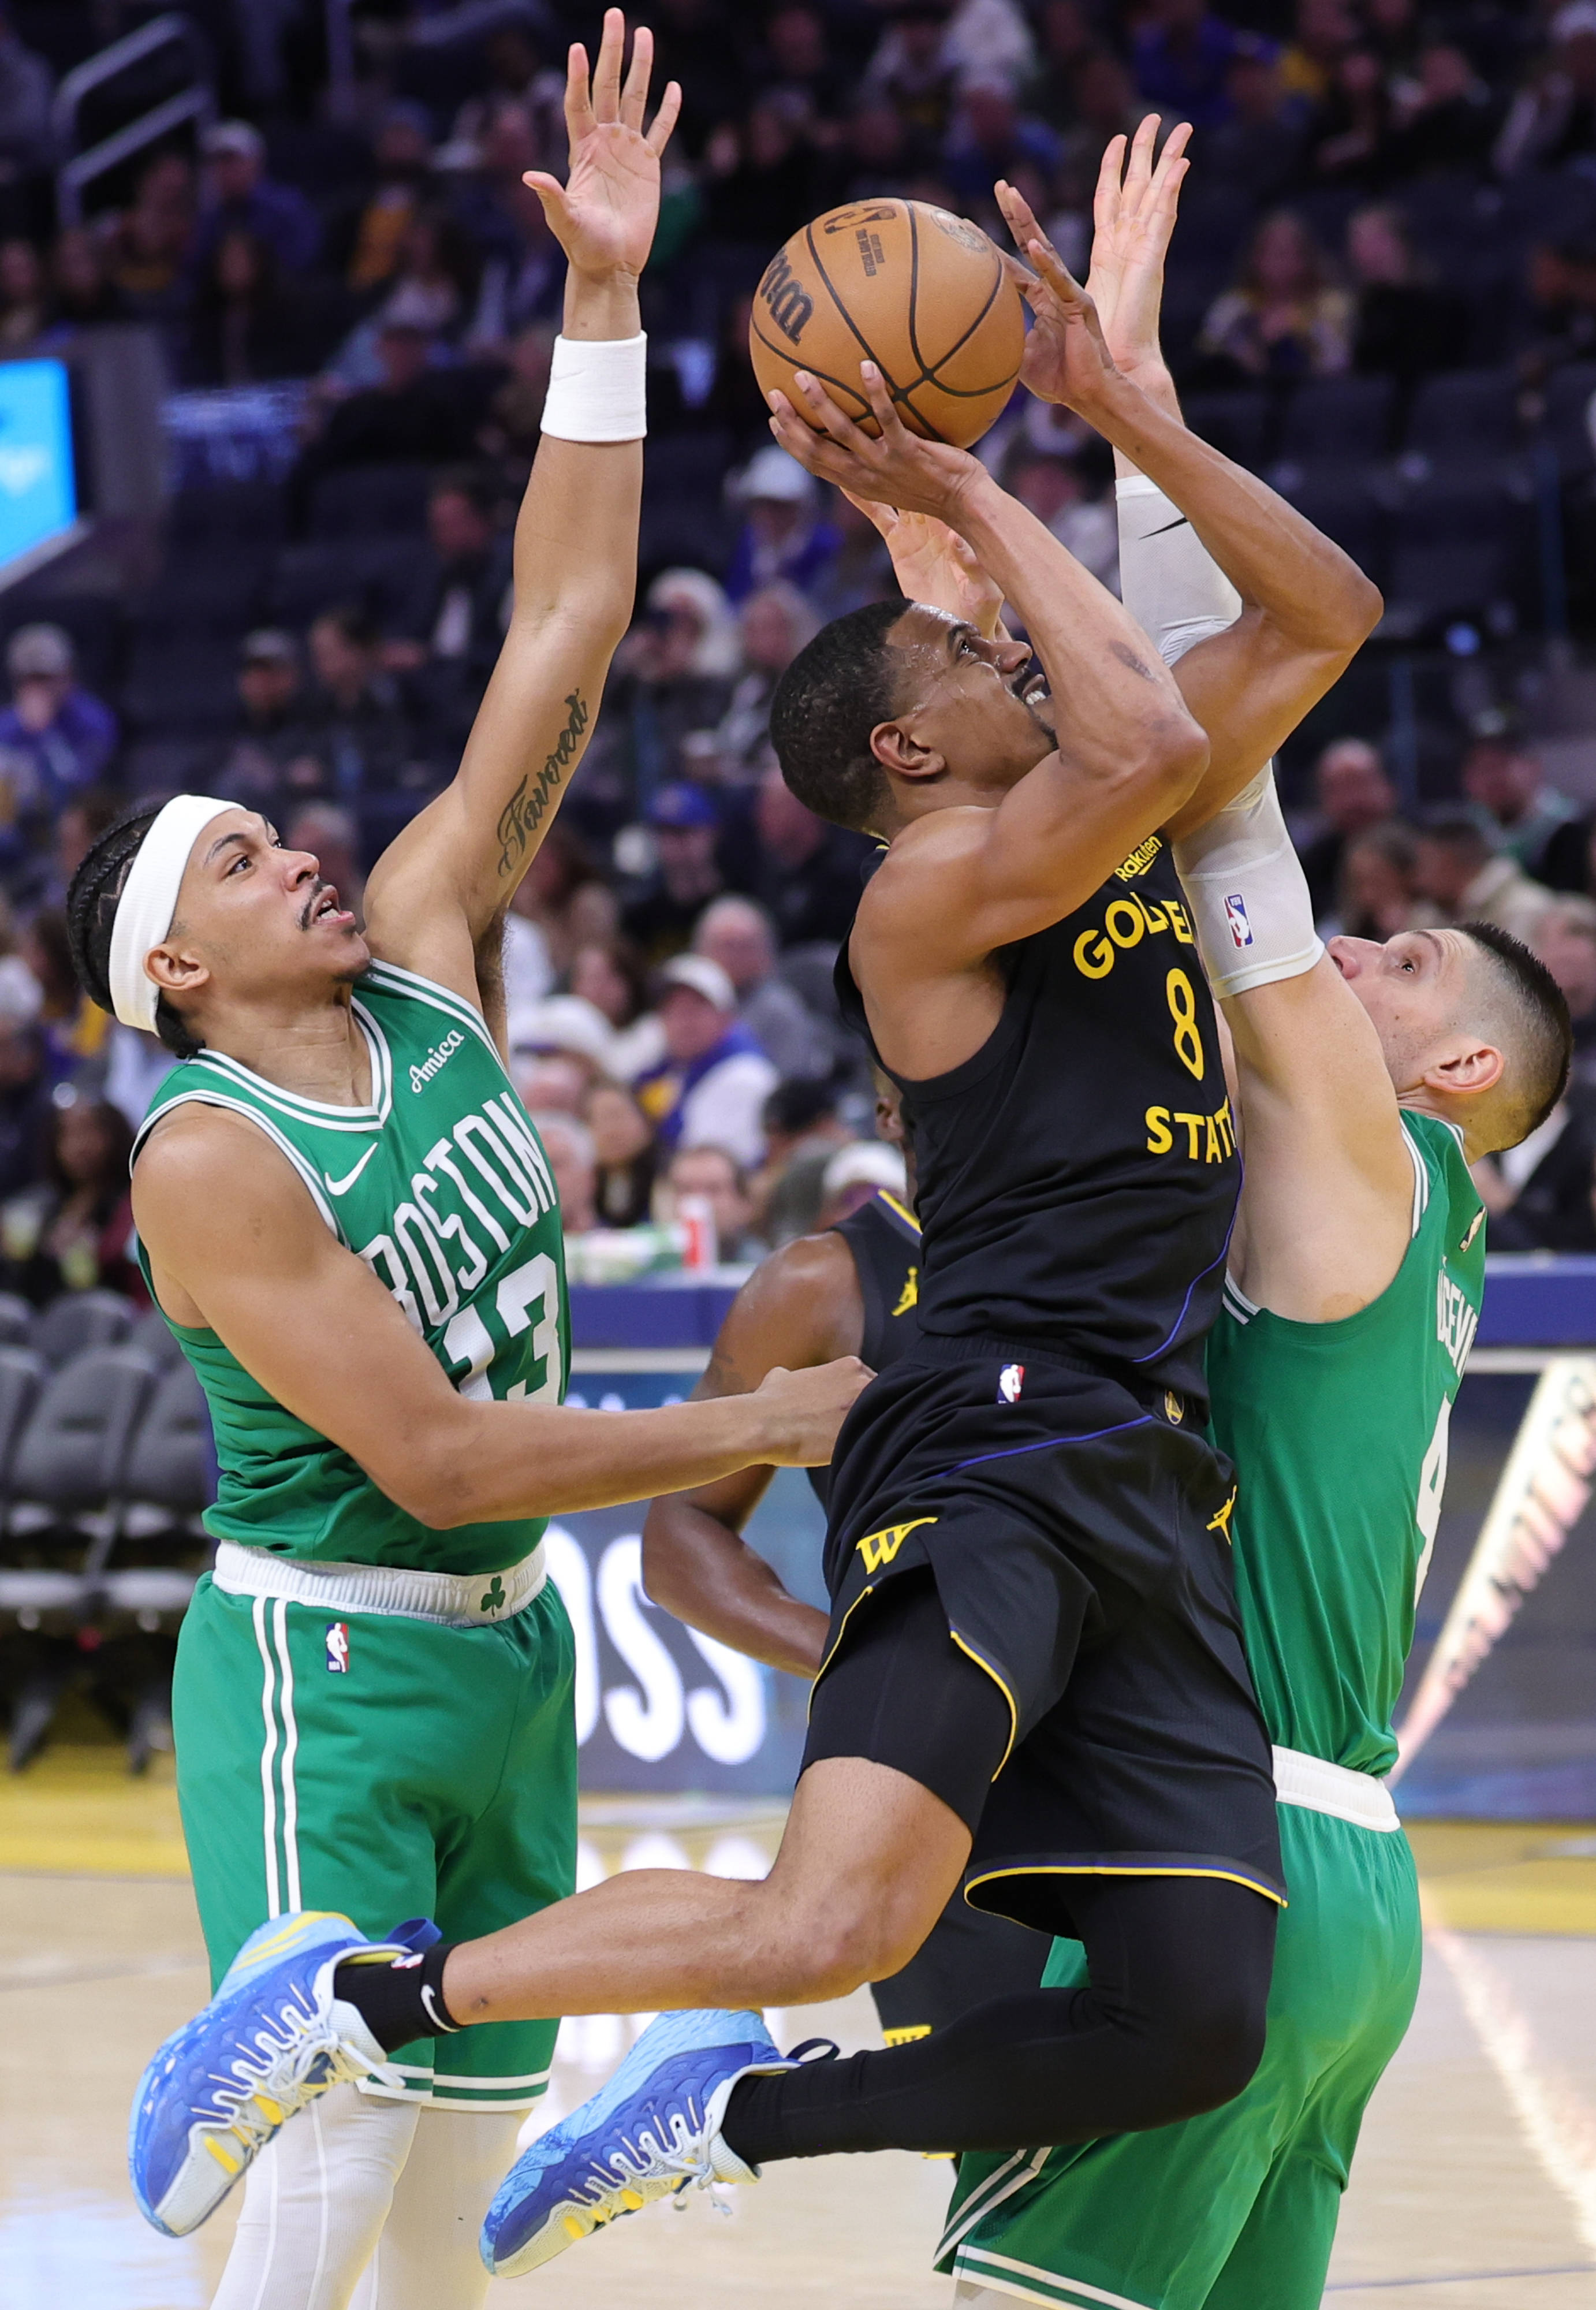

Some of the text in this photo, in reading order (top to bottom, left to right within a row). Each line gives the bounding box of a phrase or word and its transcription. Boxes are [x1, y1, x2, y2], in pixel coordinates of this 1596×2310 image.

[498, 688, 588, 877] Favored
[1114, 836, 1163, 882] Rakuten
[410, 1029, 465, 1094] Amica
[1166, 968, 1205, 1081] 8
[355, 1091, 557, 1337] BOSTON
[443, 1252, 560, 1406] 13
